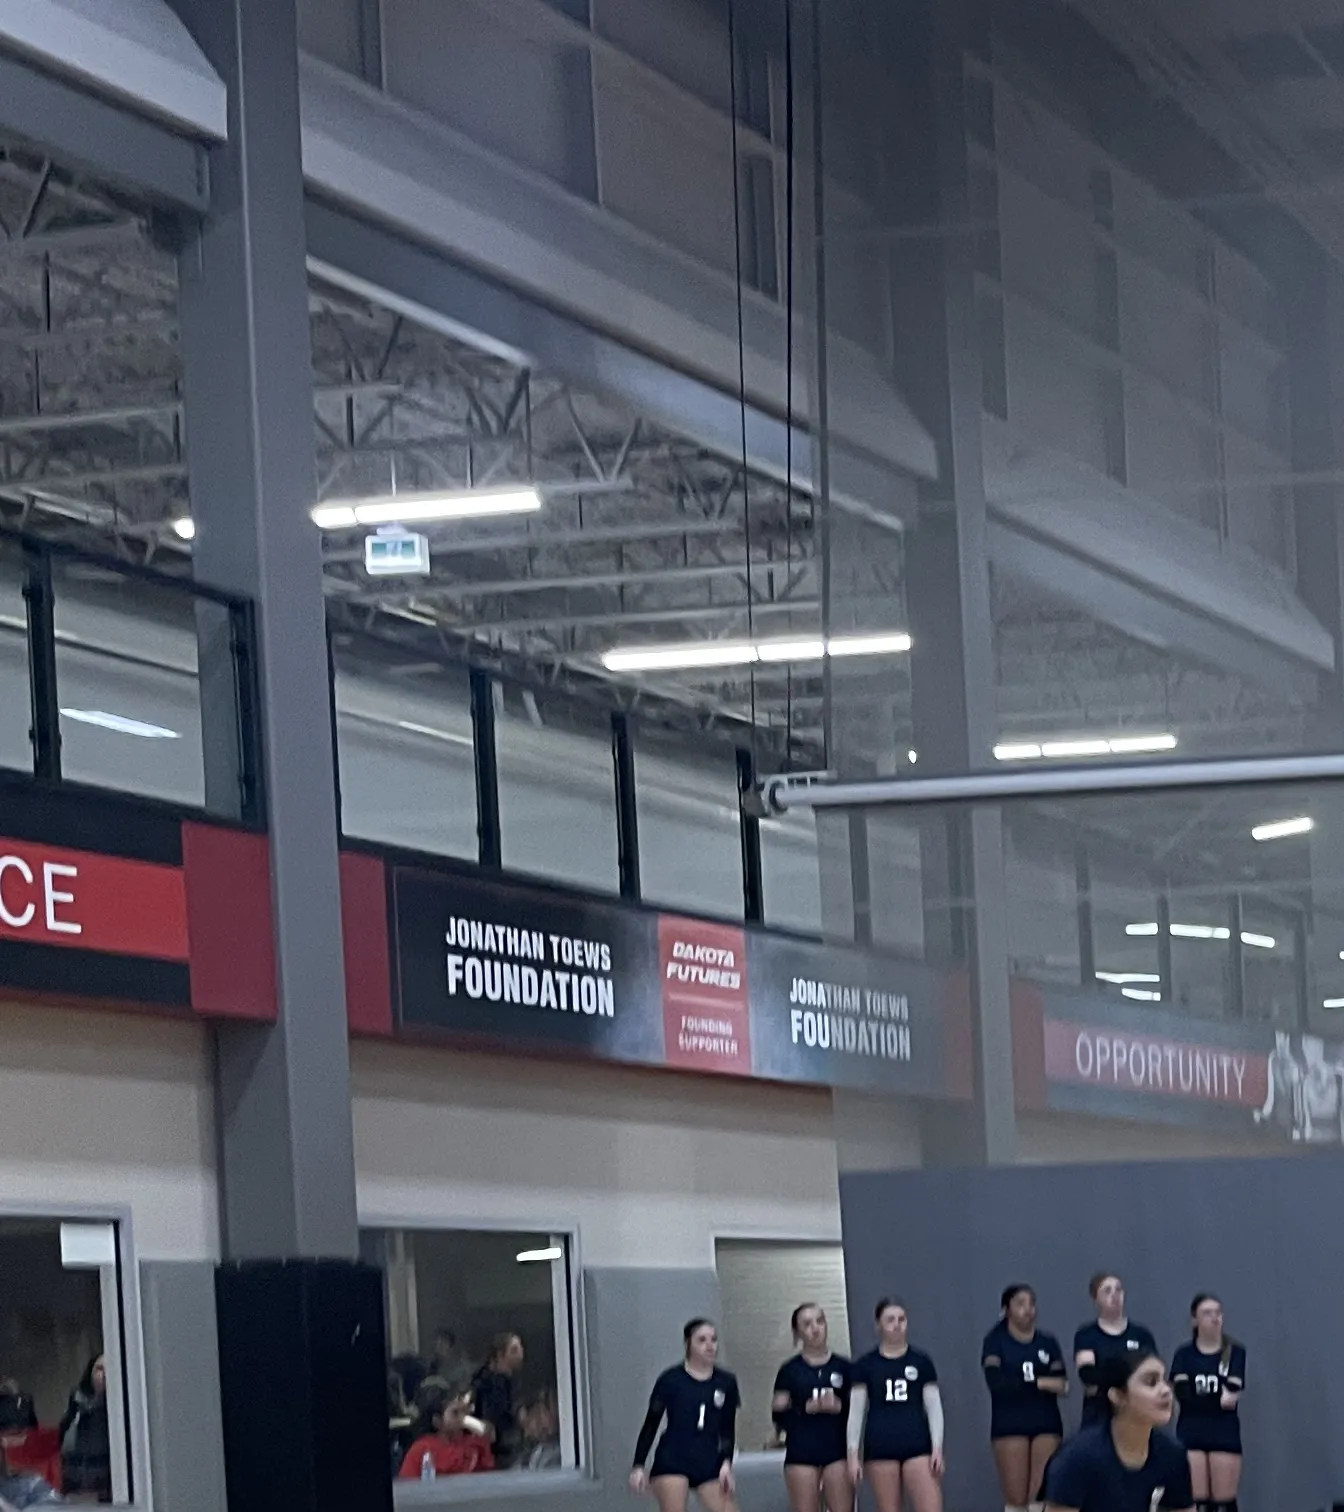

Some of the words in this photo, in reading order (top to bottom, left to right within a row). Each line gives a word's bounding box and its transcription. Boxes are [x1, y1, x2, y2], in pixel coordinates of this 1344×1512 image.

[0, 855, 81, 934] CE
[446, 916, 544, 961] JONATHAN
[549, 934, 611, 971] TOEWS
[673, 941, 735, 968] DAKOTA
[447, 953, 614, 1017] FOUNDATION
[666, 961, 740, 989] FUTURES
[790, 977, 860, 1014] JONATHAN
[864, 988, 908, 1022] TOEWS
[790, 1008, 910, 1061] FOUNDATION
[1076, 1031, 1246, 1099] OPPORTUNITY
[885, 1379, 908, 1401] 12
[697, 1404, 706, 1430] 1
